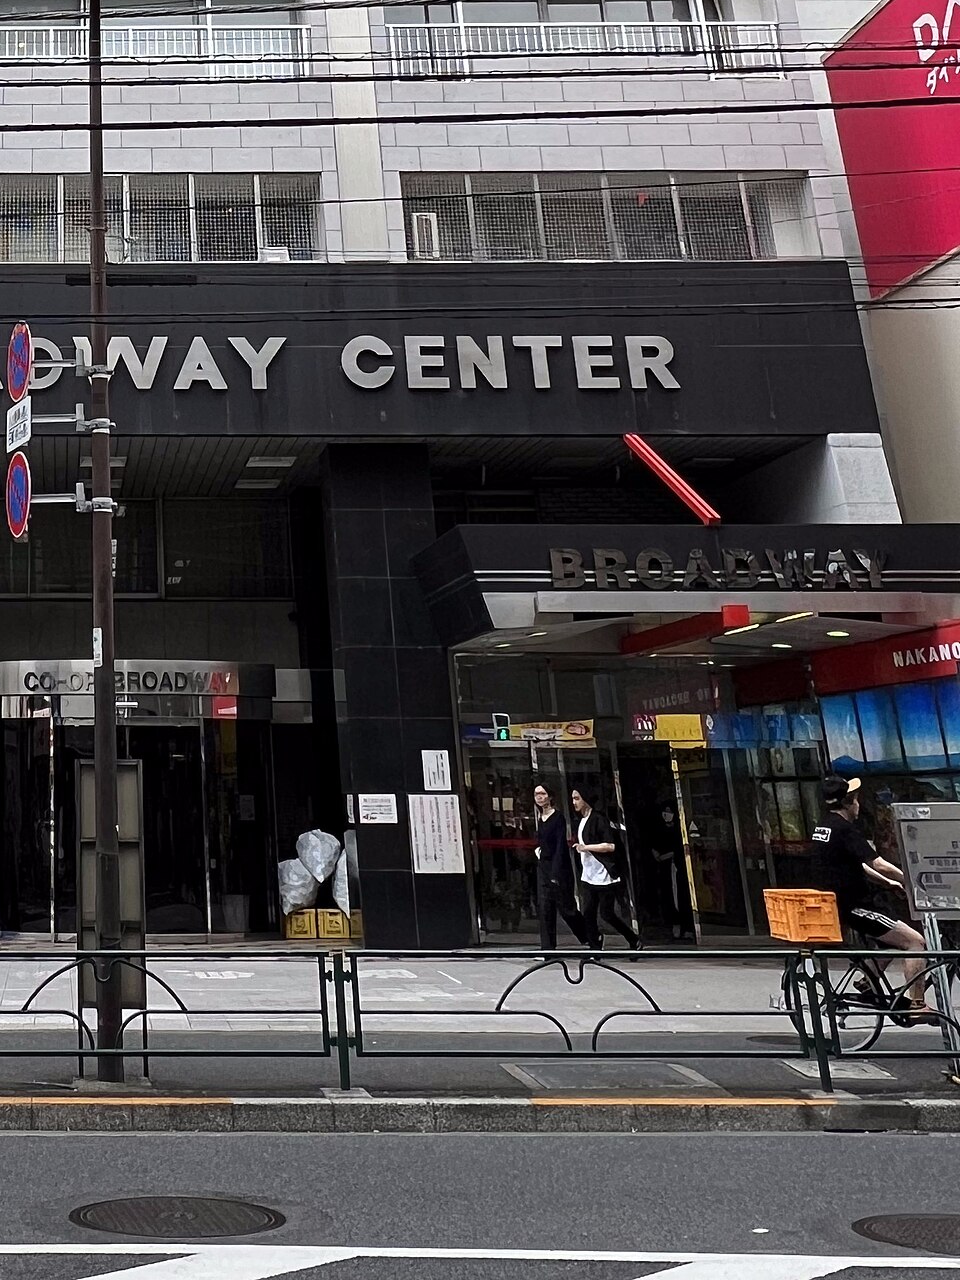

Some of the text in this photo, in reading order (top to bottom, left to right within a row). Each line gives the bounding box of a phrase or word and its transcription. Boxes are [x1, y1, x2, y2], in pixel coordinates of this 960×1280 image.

[340, 335, 681, 390] CENTER
[549, 548, 888, 590] BROADWAY
[892, 641, 960, 668] NAKANO
[114, 671, 232, 694] BROADWAY
